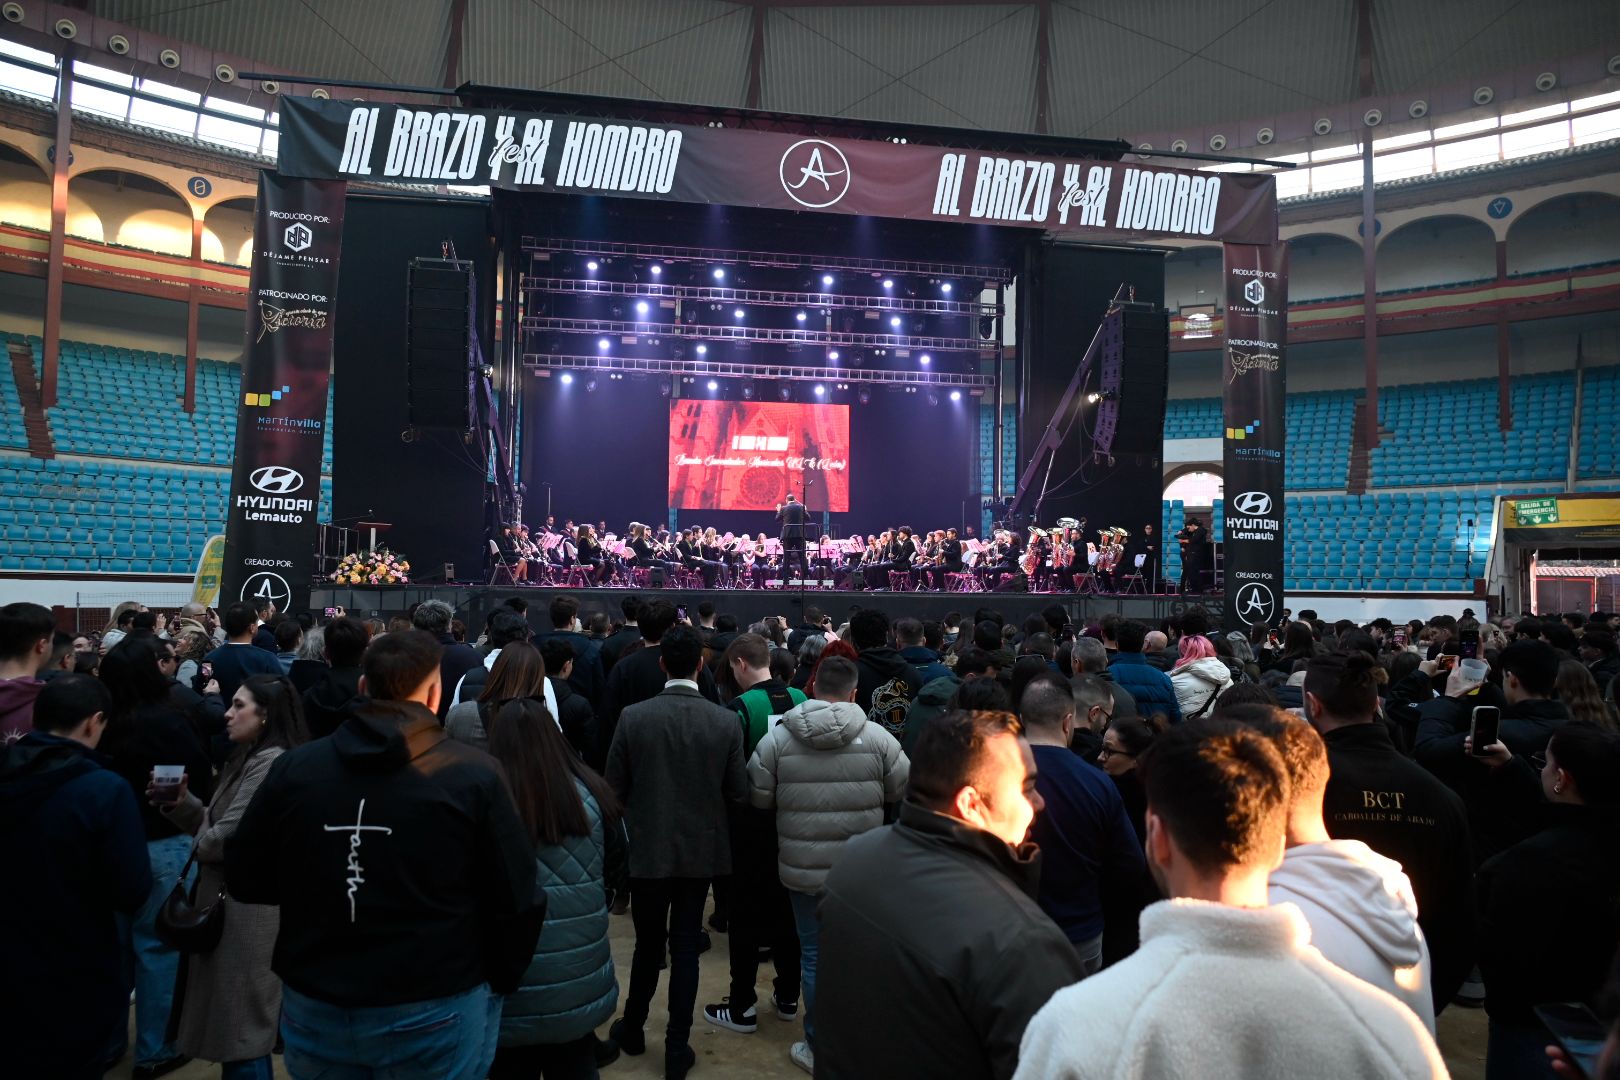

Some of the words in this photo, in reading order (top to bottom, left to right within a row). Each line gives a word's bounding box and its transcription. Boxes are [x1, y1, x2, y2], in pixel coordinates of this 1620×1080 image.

[339, 107, 380, 176] AL
[384, 109, 487, 180] BRAZO
[514, 119, 553, 185] AL
[556, 121, 683, 194] HOMBRO
[488, 136, 549, 167] fest
[933, 153, 966, 216] AL
[970, 156, 1056, 223] BRAZO
[1080, 166, 1112, 228] AL
[1116, 168, 1222, 235] HOMBRO
[1058, 182, 1109, 212] fest
[269, 210, 313, 221] PRODUCIDO
[314, 215, 331, 224] POR:
[263, 251, 295, 262] DÉJAME
[298, 255, 330, 264] PENSAR
[258, 289, 310, 301] PATROCINADO
[311, 294, 328, 303] POR:
[237, 495, 313, 512] HYUNDAI
[245, 510, 303, 524] Lemauto
[1226, 517, 1279, 531] HYUNDAI
[1232, 530, 1274, 541] Lemauto
[244, 558, 275, 567] CREADO
[276, 560, 294, 568] POR:
[1235, 571, 1260, 579] CREADO
[1362, 790, 1405, 810] BCT
[1389, 814, 1402, 822] DE
